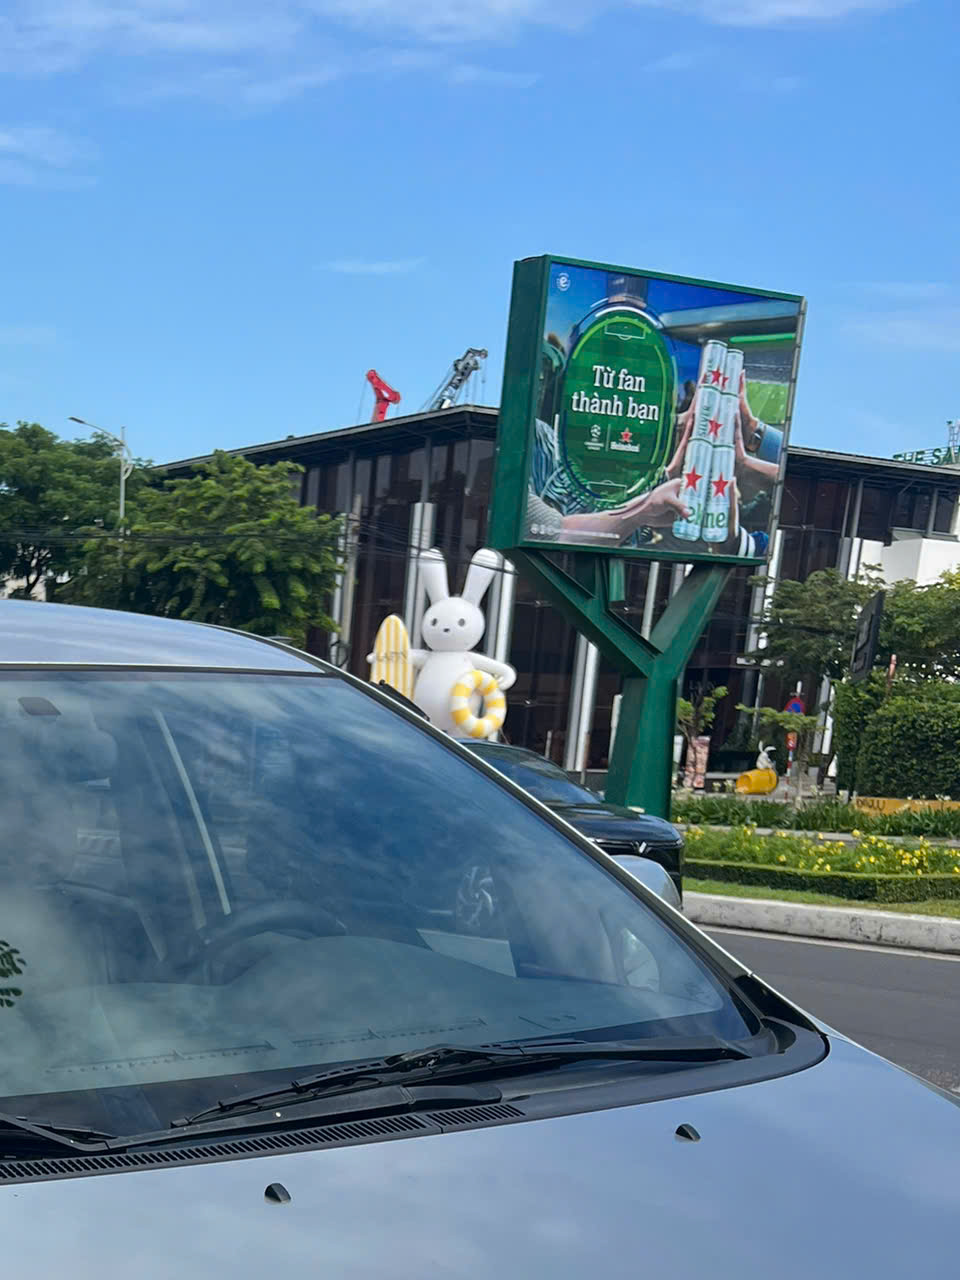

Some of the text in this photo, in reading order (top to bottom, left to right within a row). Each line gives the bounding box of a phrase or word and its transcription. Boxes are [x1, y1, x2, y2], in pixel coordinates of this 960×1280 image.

[592, 364, 646, 393] Từ fan
[571, 390, 659, 425] thành bạn
